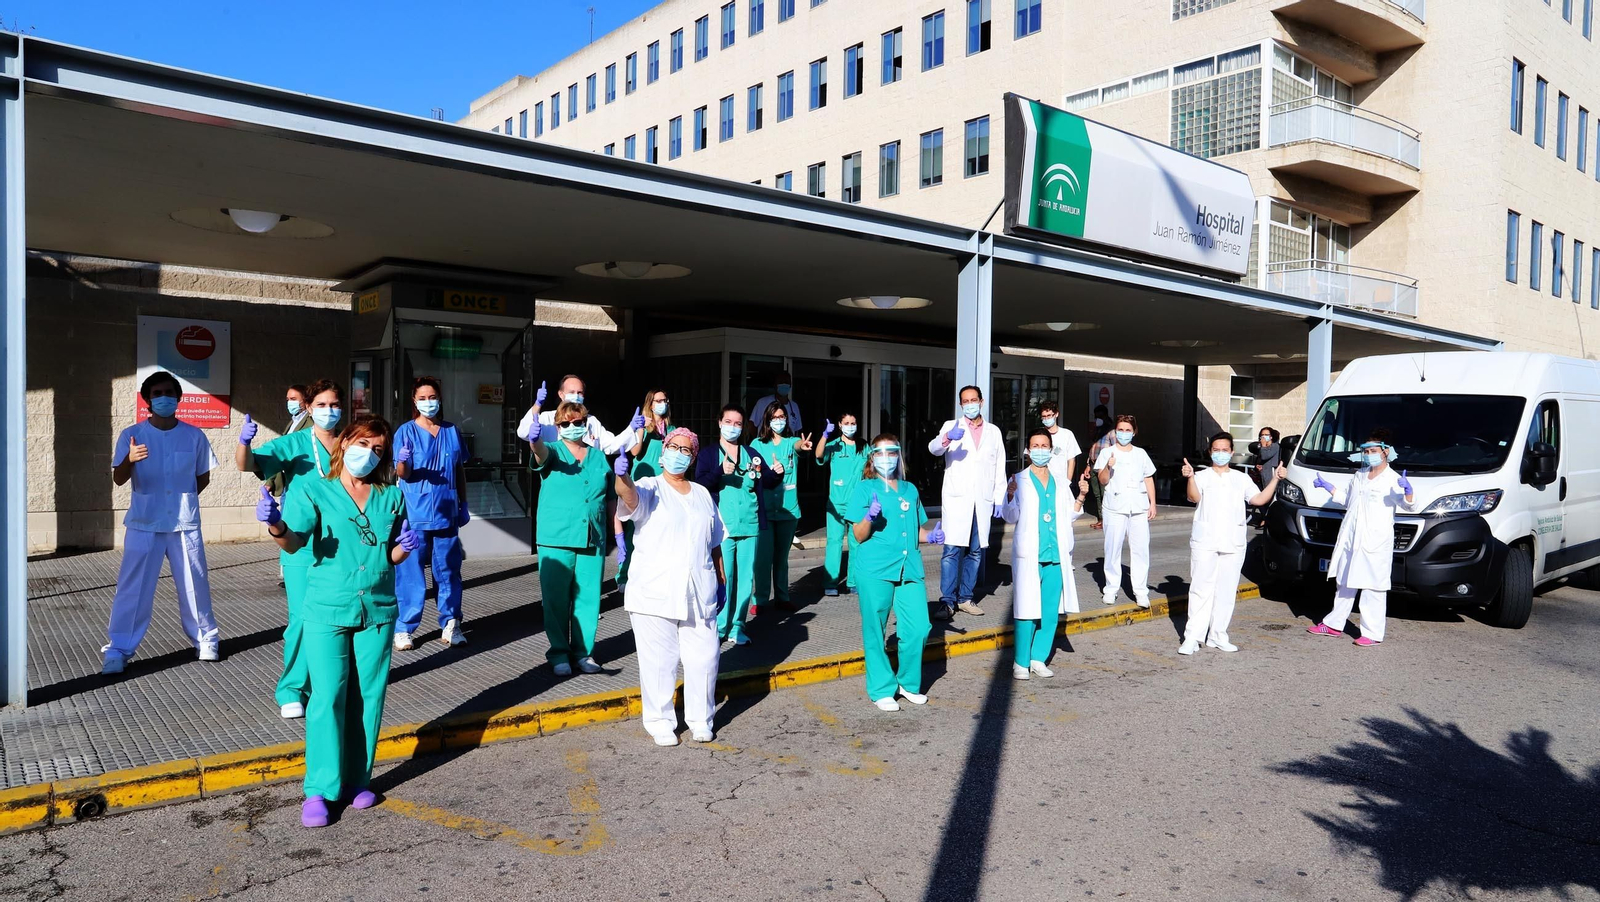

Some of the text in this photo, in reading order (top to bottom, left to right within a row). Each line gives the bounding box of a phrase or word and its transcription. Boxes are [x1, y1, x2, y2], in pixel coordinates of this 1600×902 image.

[1038, 199, 1051, 208] JUNTA
[1053, 202, 1058, 210] DE
[1196, 204, 1244, 236] Hospital
[1153, 221, 1241, 256] Juan Ramón Jiménez
[360, 294, 377, 310] ONCE
[451, 293, 499, 310] ONCE
